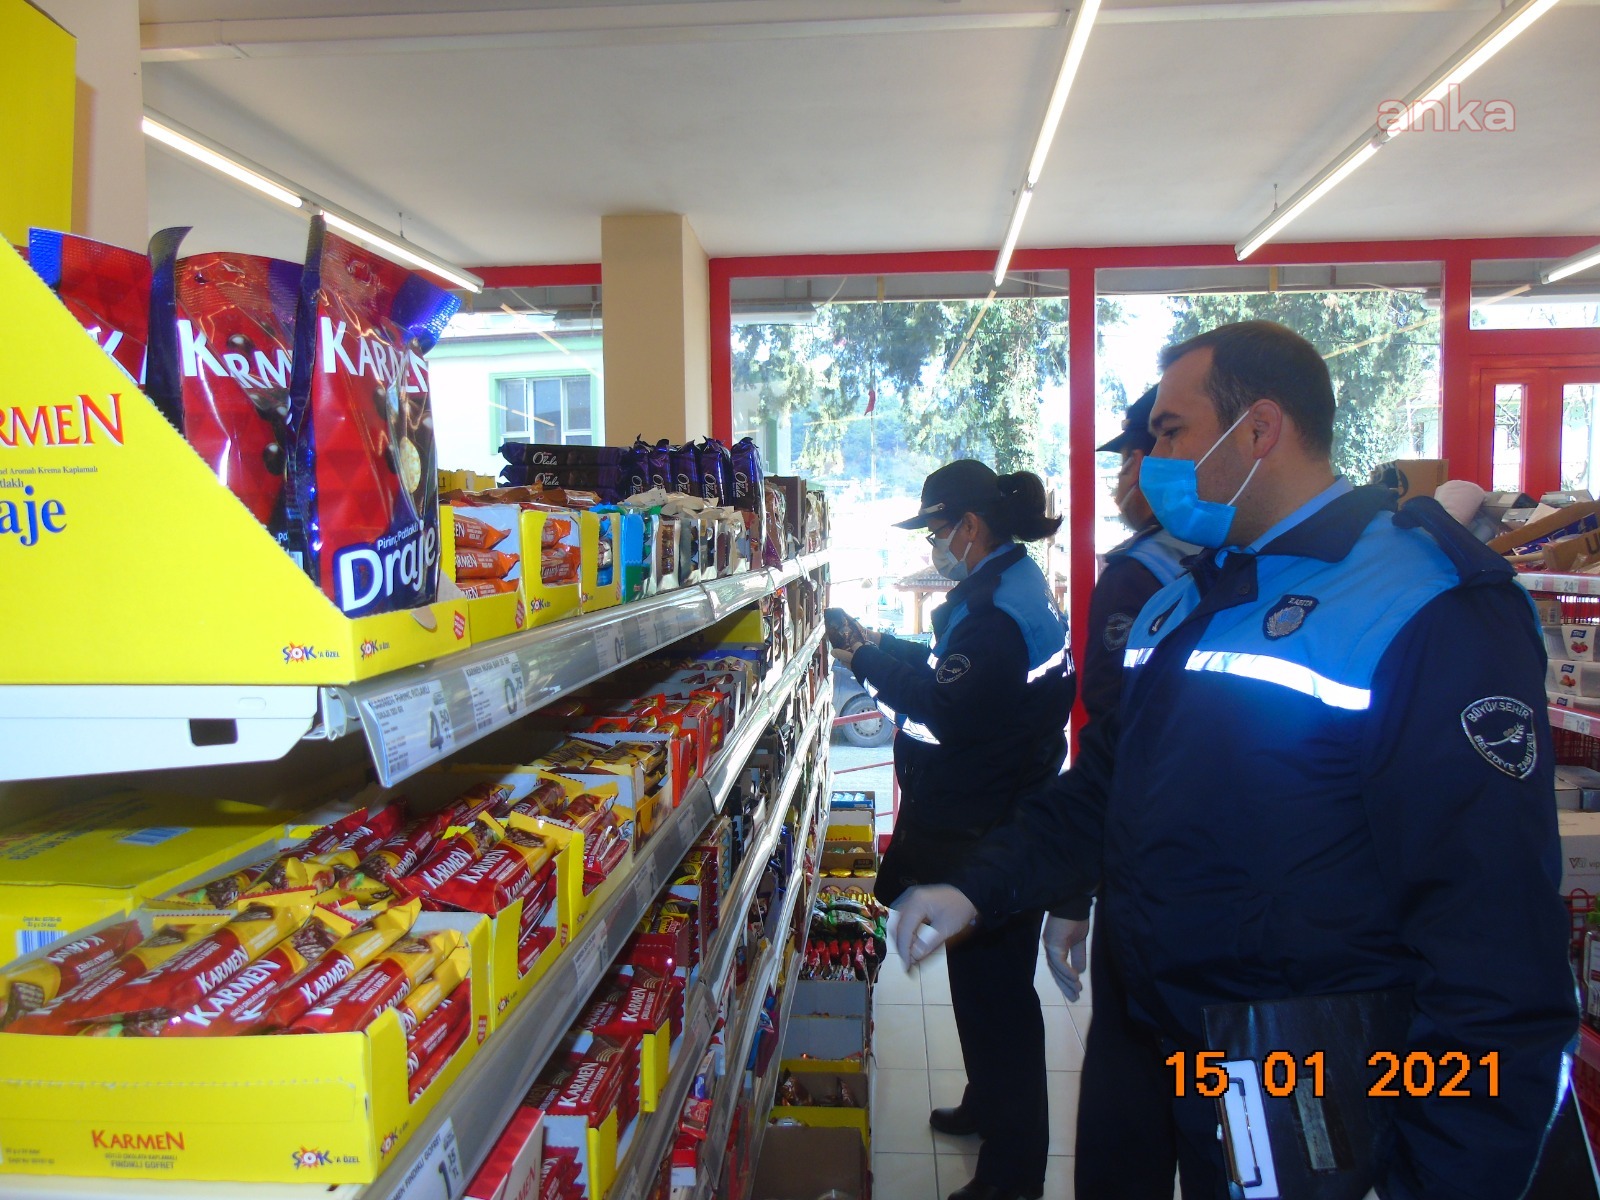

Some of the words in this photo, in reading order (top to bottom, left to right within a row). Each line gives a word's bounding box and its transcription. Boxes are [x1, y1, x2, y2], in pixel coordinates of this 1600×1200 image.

[340, 521, 436, 612] Draje
[429, 710, 445, 751] 4
[421, 847, 472, 889] KARMEN
[456, 849, 509, 885] KARMEN
[196, 944, 249, 995] KARMEN
[299, 953, 356, 1005] KARMEN
[184, 959, 281, 1027] KARMEN
[621, 986, 648, 1022] KARMEN
[558, 1062, 600, 1108] KARMEN
[91, 1129, 185, 1151] KARMEN
